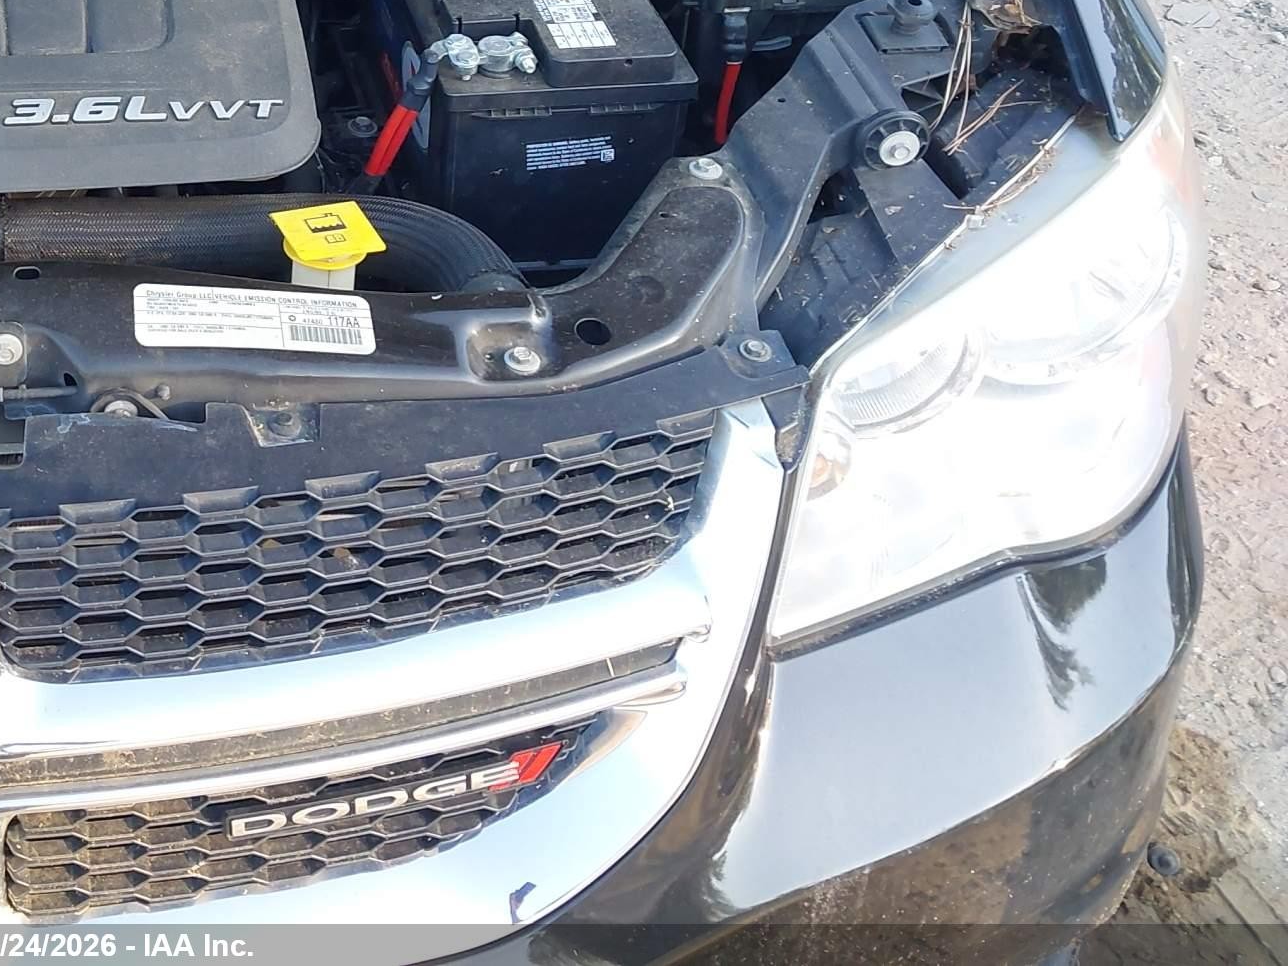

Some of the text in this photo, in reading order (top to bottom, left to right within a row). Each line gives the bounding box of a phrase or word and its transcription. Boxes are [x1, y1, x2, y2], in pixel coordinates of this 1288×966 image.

[4, 95, 283, 125] 3.6L VVT
[146, 289, 174, 298] Chrysler
[215, 293, 242, 301] VEHICLE
[244, 294, 276, 303] EMISSION
[278, 297, 308, 305] CONTROL
[310, 299, 357, 308] INFORMATION
[328, 315, 360, 329] 117AA
[231, 760, 520, 838] DODGE
